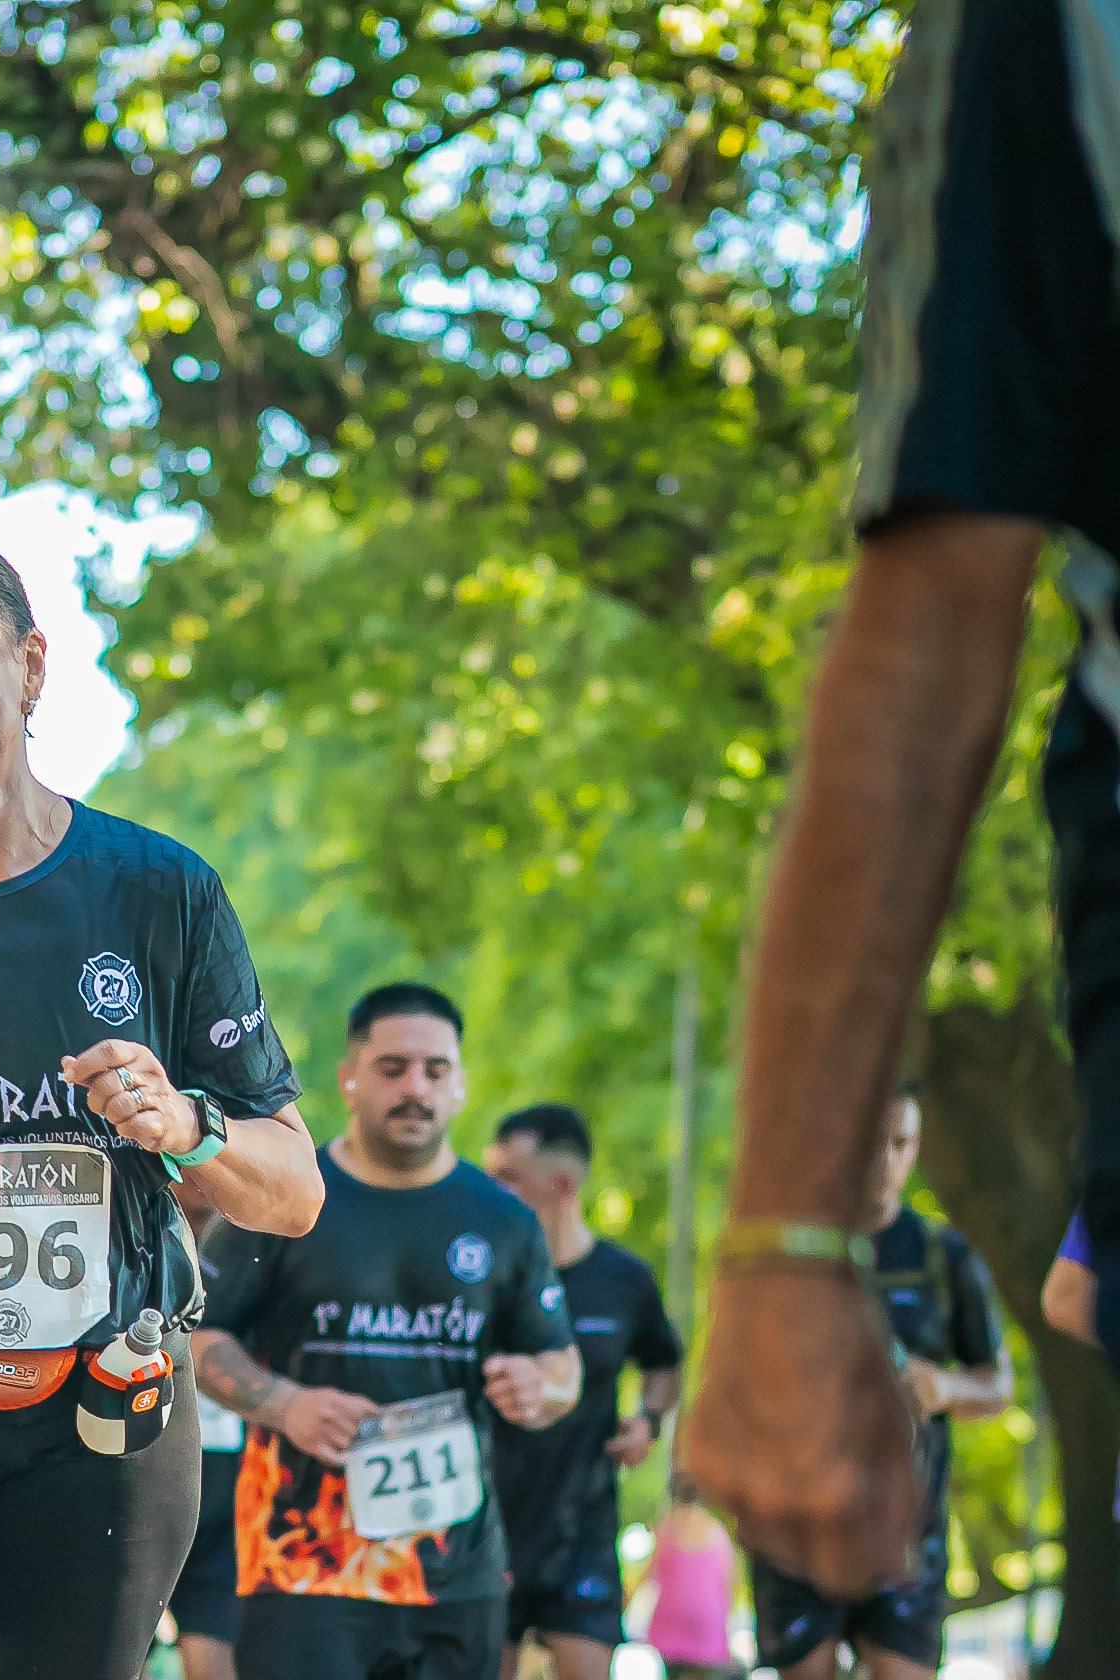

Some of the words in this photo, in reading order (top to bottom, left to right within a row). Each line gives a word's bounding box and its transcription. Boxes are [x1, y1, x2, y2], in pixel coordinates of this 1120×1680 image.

[100, 974, 123, 997] 27
[10, 1194, 62, 1206] VOLUNTARIOS
[63, 1192, 100, 1205] ROSARIO
[0, 1313, 18, 1330] 27
[364, 1441, 460, 1499] 211
